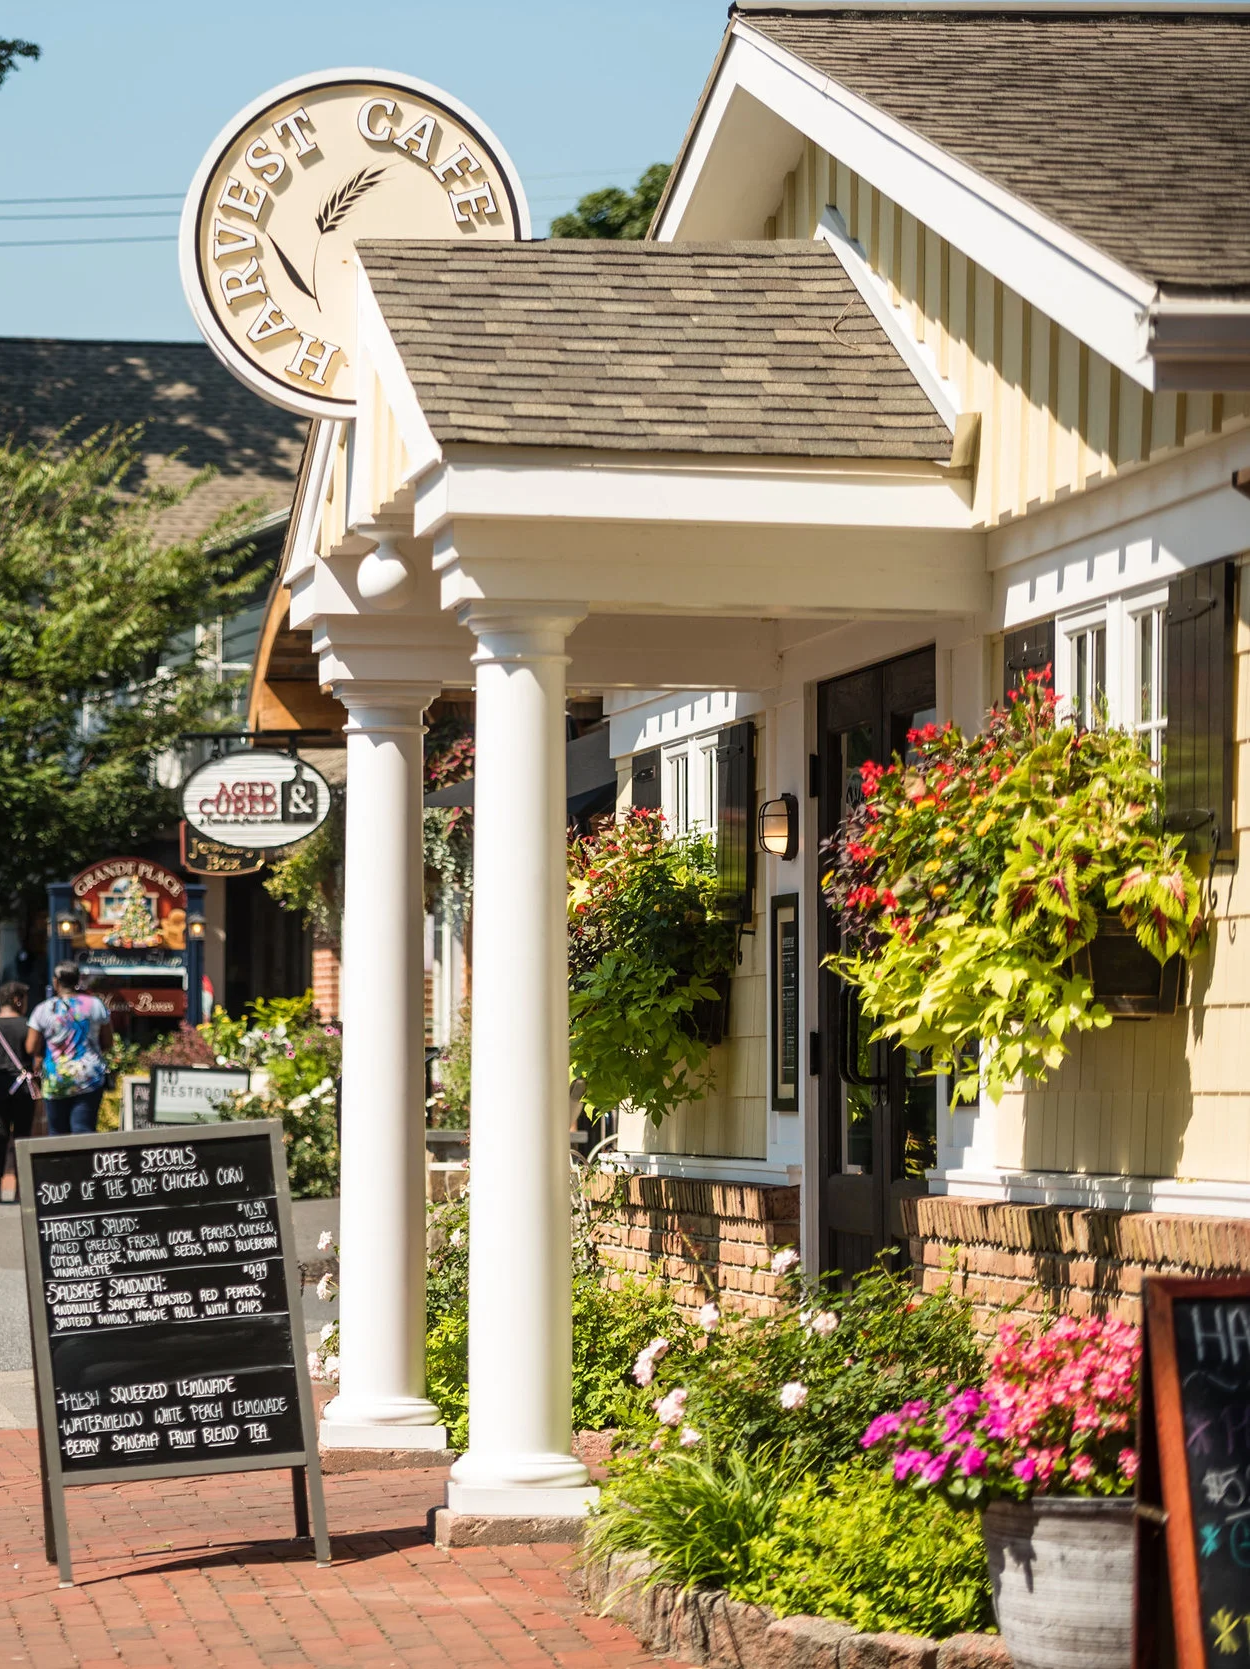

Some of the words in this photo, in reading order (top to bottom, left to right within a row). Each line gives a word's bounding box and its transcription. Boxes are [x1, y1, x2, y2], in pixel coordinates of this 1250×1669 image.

[213, 107, 341, 385] HARVEST
[357, 98, 498, 223] CAFE
[216, 782, 276, 799] AGED
[288, 784, 314, 814] &
[199, 797, 277, 815] CURED
[138, 862, 184, 898] PLACE
[141, 1147, 196, 1168] SPECIALS
[81, 1181, 95, 1198] OF
[102, 1179, 128, 1197] THE
[132, 1178, 157, 1195] DAY:
[162, 1169, 209, 1191] CHICKEN
[216, 1166, 244, 1185] CORN
[237, 1200, 268, 1218] $10.99
[101, 1217, 140, 1237] SALAD:
[50, 1254, 83, 1269] COTIJA
[127, 1246, 168, 1263] PUMPKIN
[208, 1240, 229, 1254] AND
[235, 1235, 278, 1253] BLUEBERRY
[51, 1241, 80, 1255] MIXED
[127, 1233, 160, 1250] FRESH
[168, 1230, 195, 1246] LOCAL
[53, 1264, 113, 1278] VINAIGRETTE
[109, 1275, 168, 1297] SANDWICH:
[53, 1301, 102, 1316] ANDOUILLE
[153, 1292, 192, 1307] ROASTED
[199, 1288, 218, 1303] RED
[54, 1316, 92, 1331] SAUTEED
[135, 1308, 169, 1323] HOAGIE
[206, 1301, 229, 1316] WITH
[236, 1299, 262, 1314] CHIPS
[110, 1383, 168, 1404] SQUEEZED
[176, 1376, 237, 1397] LEMONADE
[154, 1406, 186, 1424] WHITE
[189, 1402, 224, 1420] PEACH
[233, 1397, 288, 1416] LEMONADE
[112, 1432, 159, 1451] SANGRIA
[168, 1429, 197, 1446] FRUIT
[202, 1425, 239, 1444] BLEND
[244, 1423, 268, 1439] TEA
